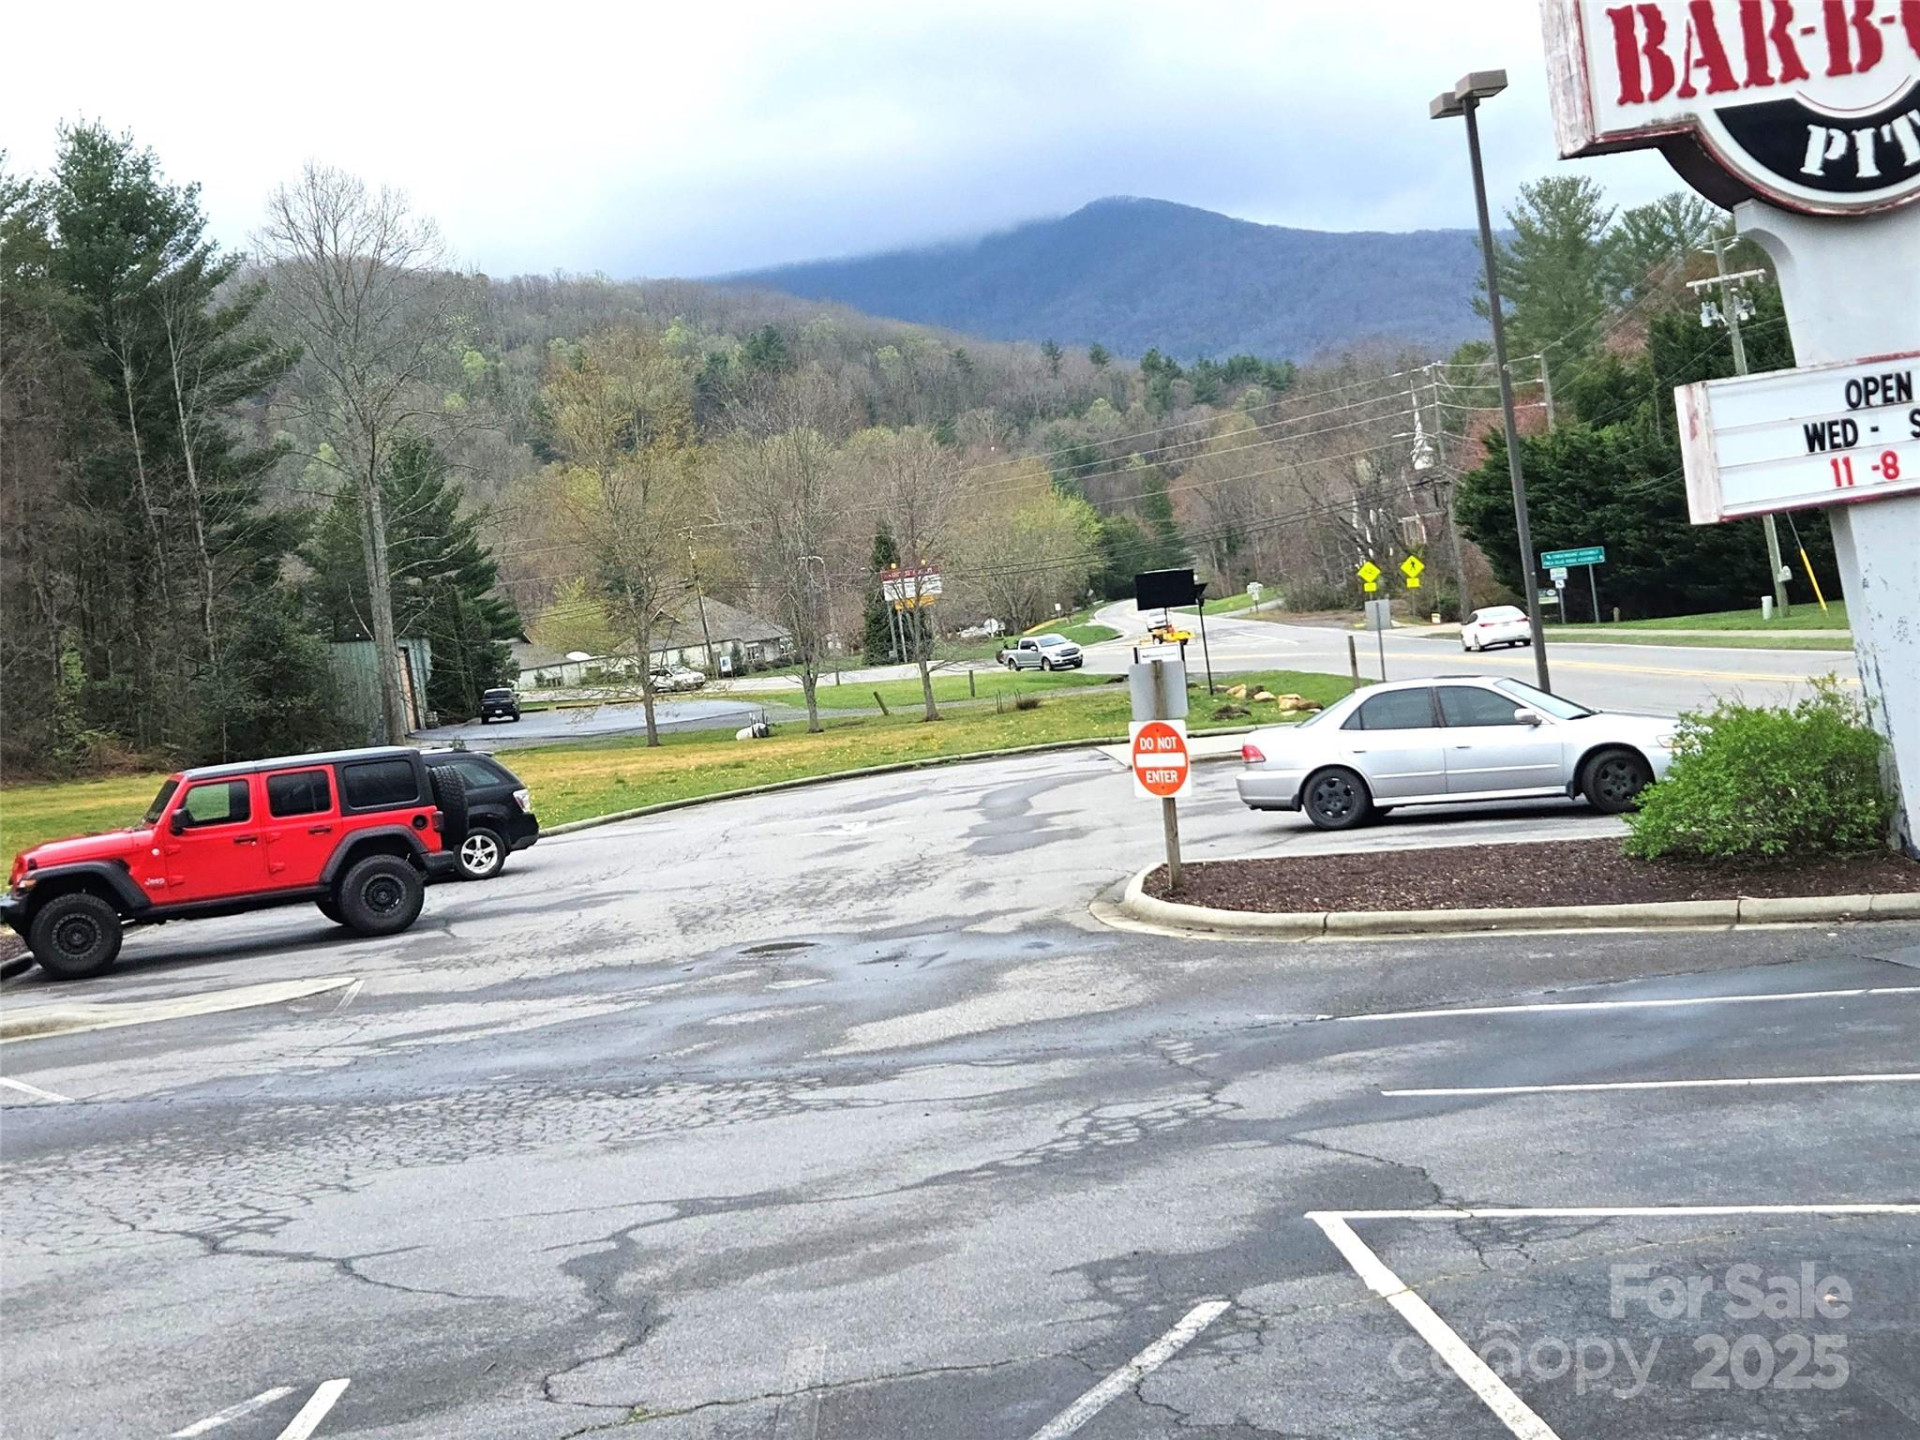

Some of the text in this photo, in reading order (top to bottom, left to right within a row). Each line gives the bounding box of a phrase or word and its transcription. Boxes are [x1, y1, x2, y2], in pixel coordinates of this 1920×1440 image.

[1606, 0, 1920, 105] BAR-B-
[1800, 108, 1920, 178] PIT
[1844, 371, 1913, 409] OPEN
[1804, 418, 1858, 453] WED
[1830, 456, 1854, 487] 11
[1140, 736, 1177, 750] DO NOT
[1146, 770, 1178, 783] ENTER
